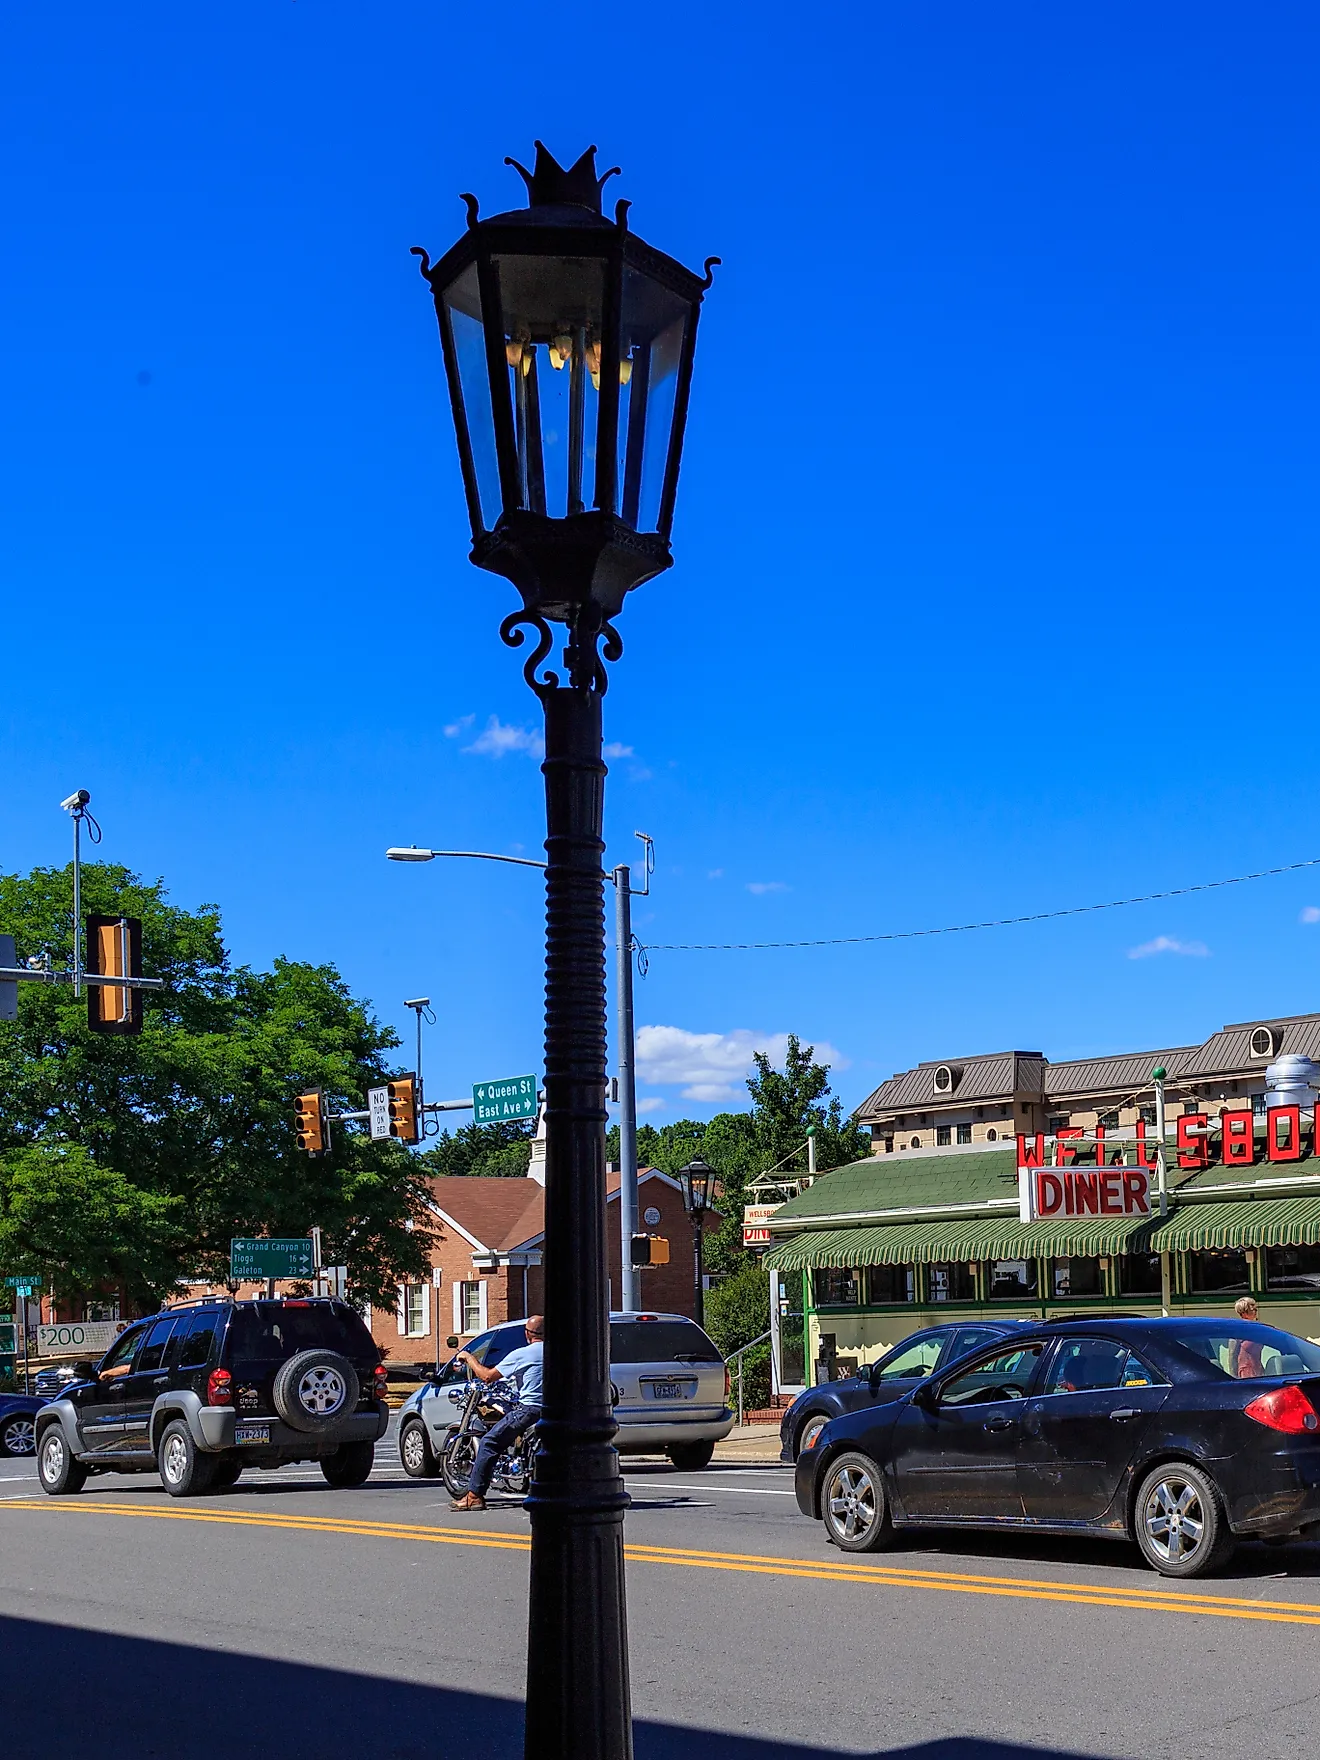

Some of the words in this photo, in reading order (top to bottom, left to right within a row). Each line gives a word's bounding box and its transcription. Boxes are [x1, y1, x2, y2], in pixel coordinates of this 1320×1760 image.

[487, 1083, 517, 1100] Queen
[520, 1079, 531, 1094] St
[373, 1092, 385, 1104] NO
[479, 1102, 501, 1118] East
[503, 1097, 520, 1114] Ave
[376, 1116, 384, 1124] ON
[376, 1126, 386, 1135] RED
[1037, 1171, 1149, 1214] DINER
[748, 1209, 777, 1218] WELLSBO
[246, 1242, 269, 1251] Grand
[271, 1243, 299, 1253] Canyon
[302, 1243, 310, 1251] 10
[233, 1254, 254, 1264] Tioga
[289, 1254, 297, 1263] 16
[233, 1266, 262, 1275] Galeton
[289, 1266, 297, 1275] 23
[9, 1277, 28, 1286] Main
[30, 1276, 39, 1285] St
[39, 1326, 85, 1347] $200
